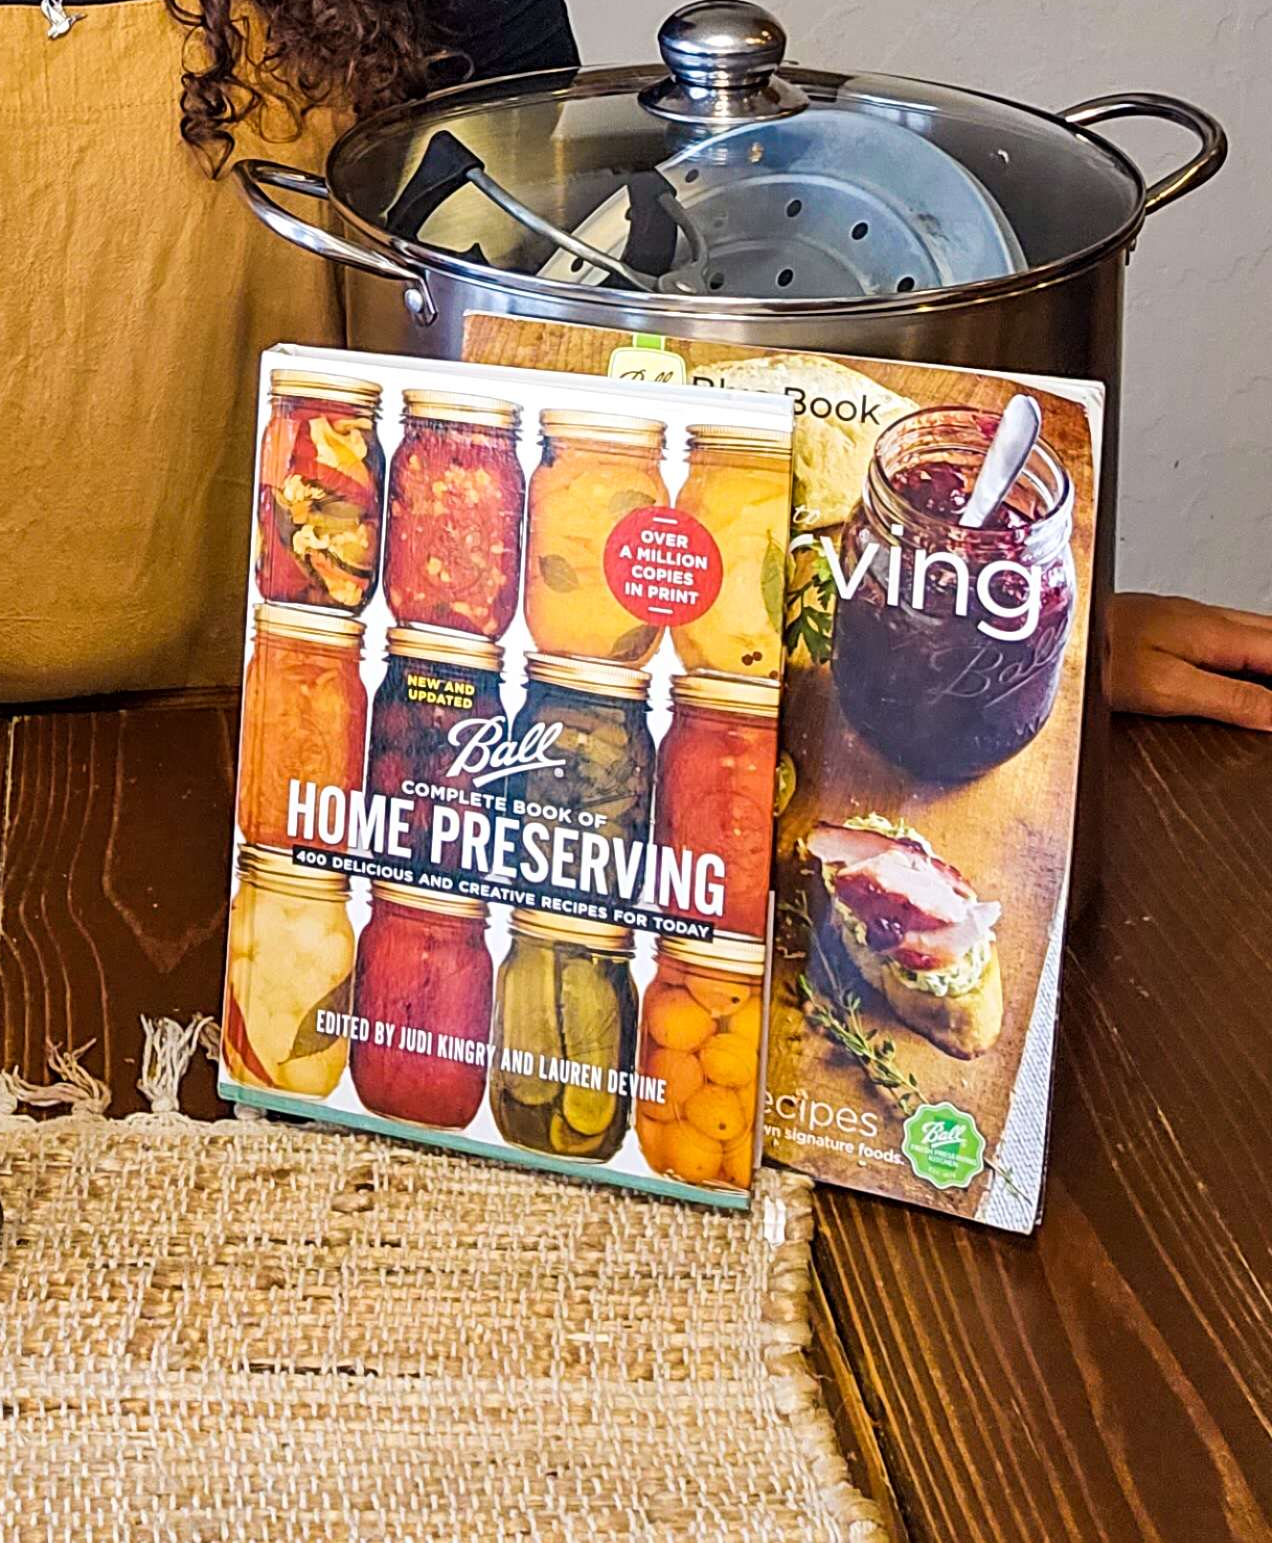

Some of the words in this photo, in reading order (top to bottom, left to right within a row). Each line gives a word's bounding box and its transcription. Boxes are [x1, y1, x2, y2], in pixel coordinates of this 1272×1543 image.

[784, 386, 882, 426] Book
[640, 530, 688, 549] OVER
[619, 545, 633, 559] A
[637, 547, 708, 570] MILLION
[631, 565, 694, 586] COPIES
[625, 581, 643, 597] IN
[648, 585, 699, 605] PRINT
[407, 674, 441, 690] NEW
[444, 681, 476, 696] AND
[408, 688, 473, 709] UPDATED
[445, 715, 566, 788] Ball
[401, 780, 507, 812] COMPLETE
[513, 799, 572, 824] BOOK
[577, 811, 608, 829] OF
[287, 778, 415, 859] HOME
[430, 804, 726, 917] PRESERVING
[296, 849, 327, 866] 400
[332, 856, 414, 883] DELICIOUS
[418, 873, 454, 890] AND
[458, 880, 536, 906] CREATIVE
[540, 896, 608, 920] RECIPES
[613, 909, 648, 928] FOR
[652, 916, 710, 939] TODAY
[316, 1009, 371, 1041] EDITED
[374, 1019, 395, 1048] BY
[398, 1027, 433, 1056] JUDI
[437, 1036, 497, 1068] KINGRY
[500, 1047, 534, 1076] AND
[539, 1054, 602, 1091] LAUREN
[606, 1070, 667, 1105] DEVINE
[785, 1127, 854, 1154] signature
[858, 1142, 905, 1166] foods.
[921, 1121, 967, 1148] Ball
